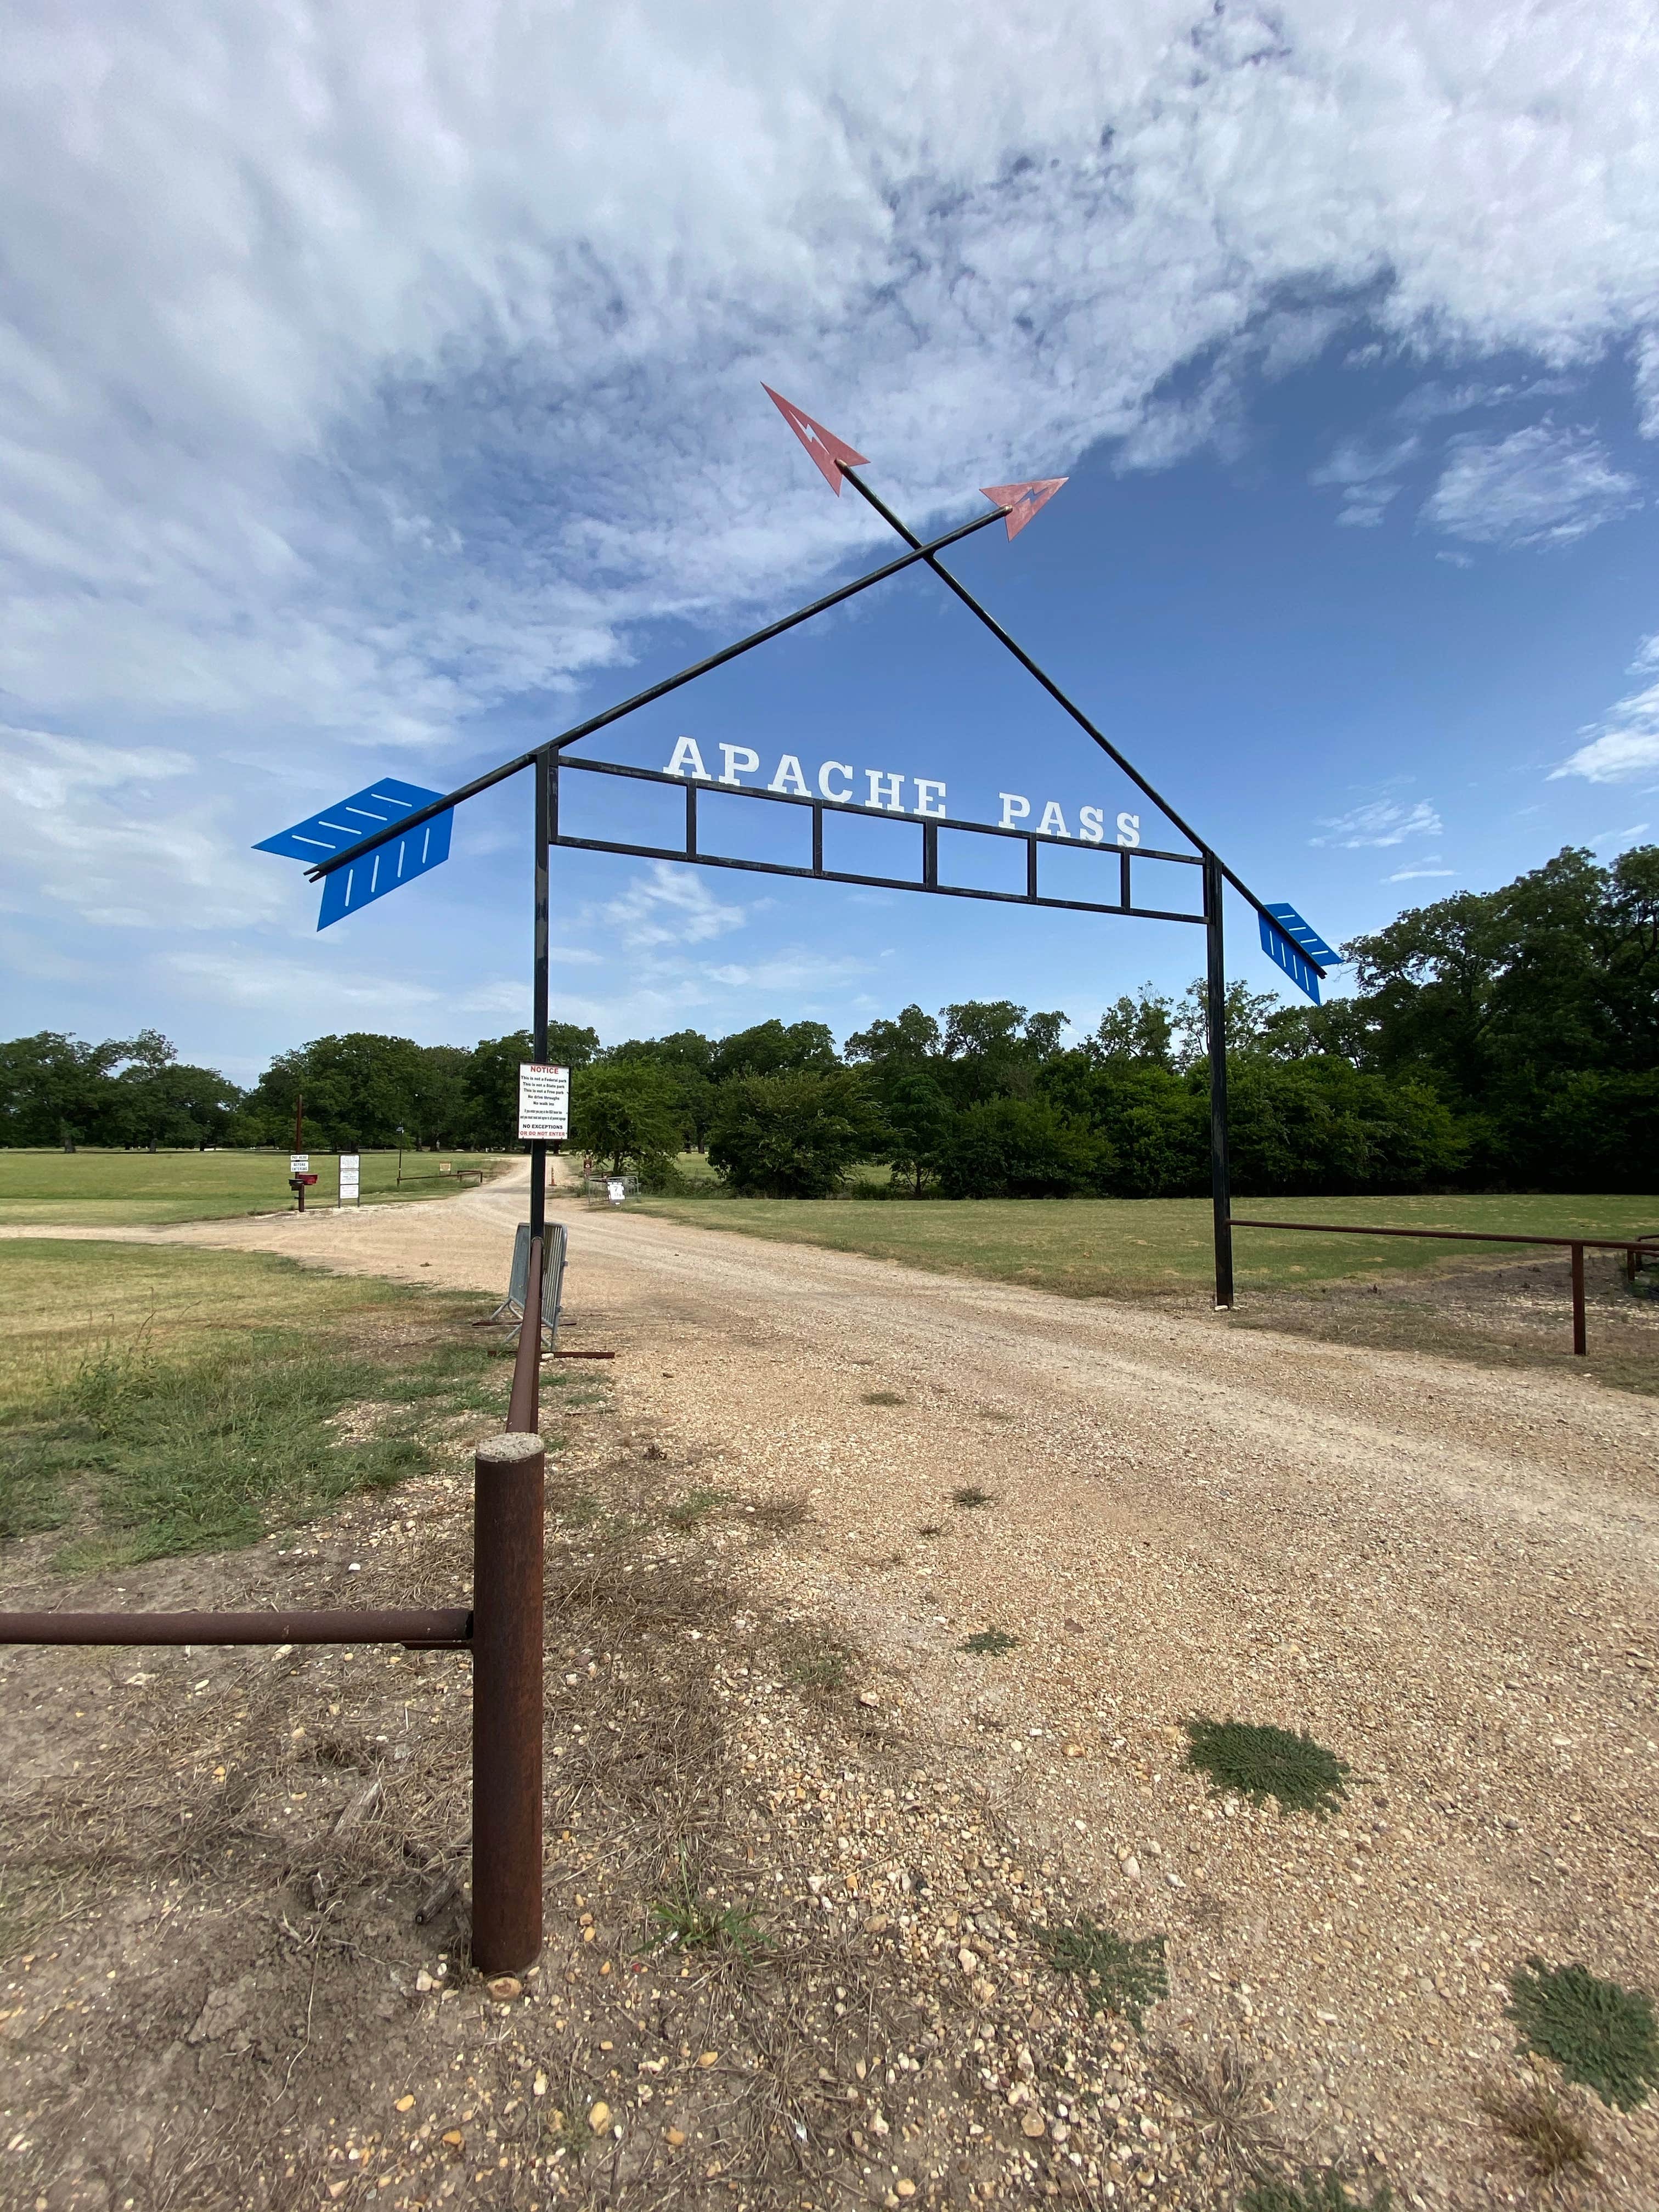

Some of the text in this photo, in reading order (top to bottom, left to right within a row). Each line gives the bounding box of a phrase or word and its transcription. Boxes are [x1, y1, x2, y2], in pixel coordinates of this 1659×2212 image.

[663, 736, 1140, 848] APACHE PASS
[531, 1066, 558, 1074] NOTICE
